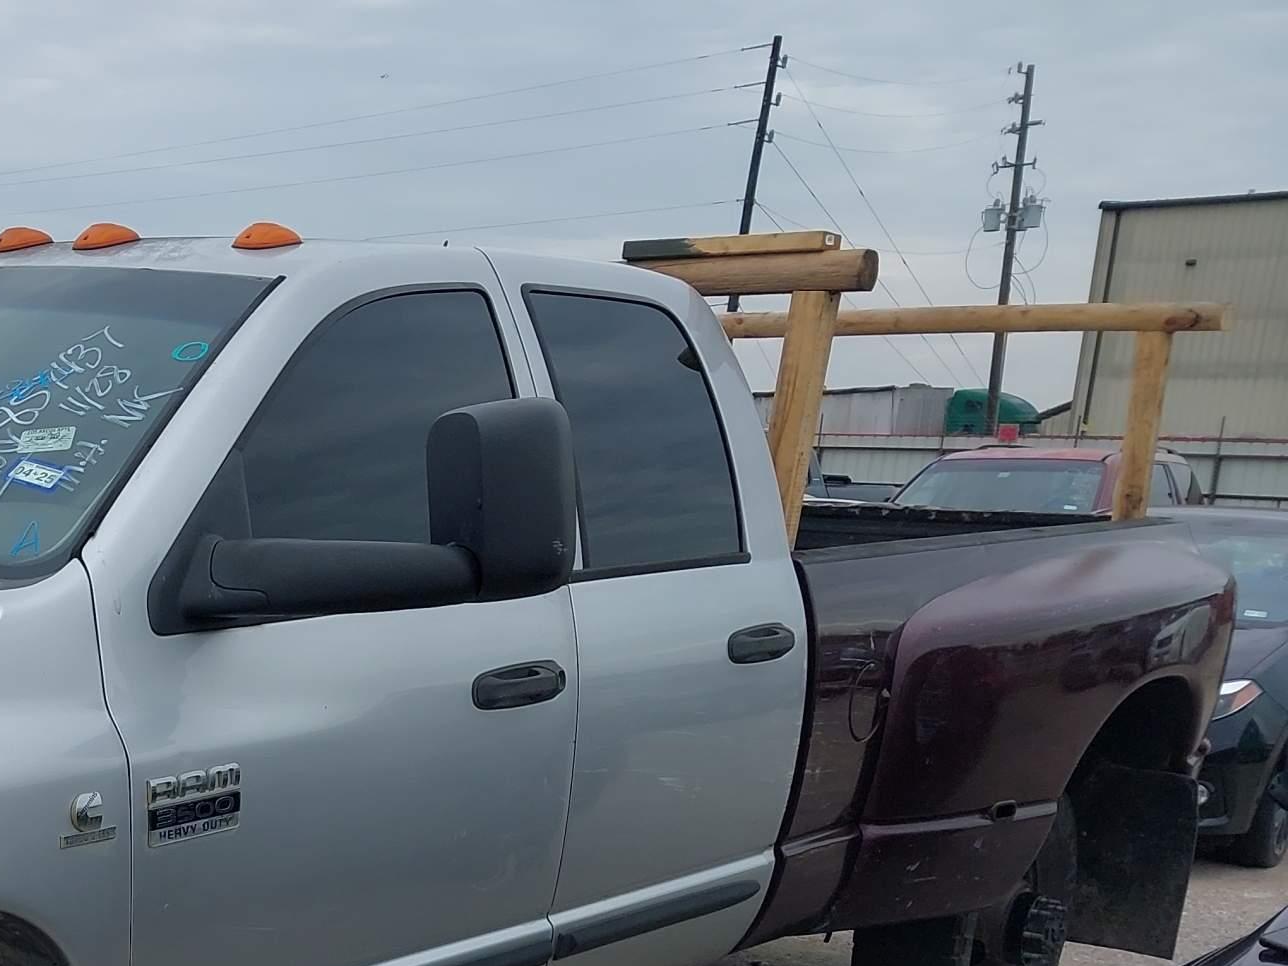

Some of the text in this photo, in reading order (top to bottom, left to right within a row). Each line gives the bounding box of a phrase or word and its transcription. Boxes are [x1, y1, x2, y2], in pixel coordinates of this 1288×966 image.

[147, 762, 240, 804] RAM
[156, 795, 234, 829] 3500
[159, 815, 233, 840] HEAVY DUTY
